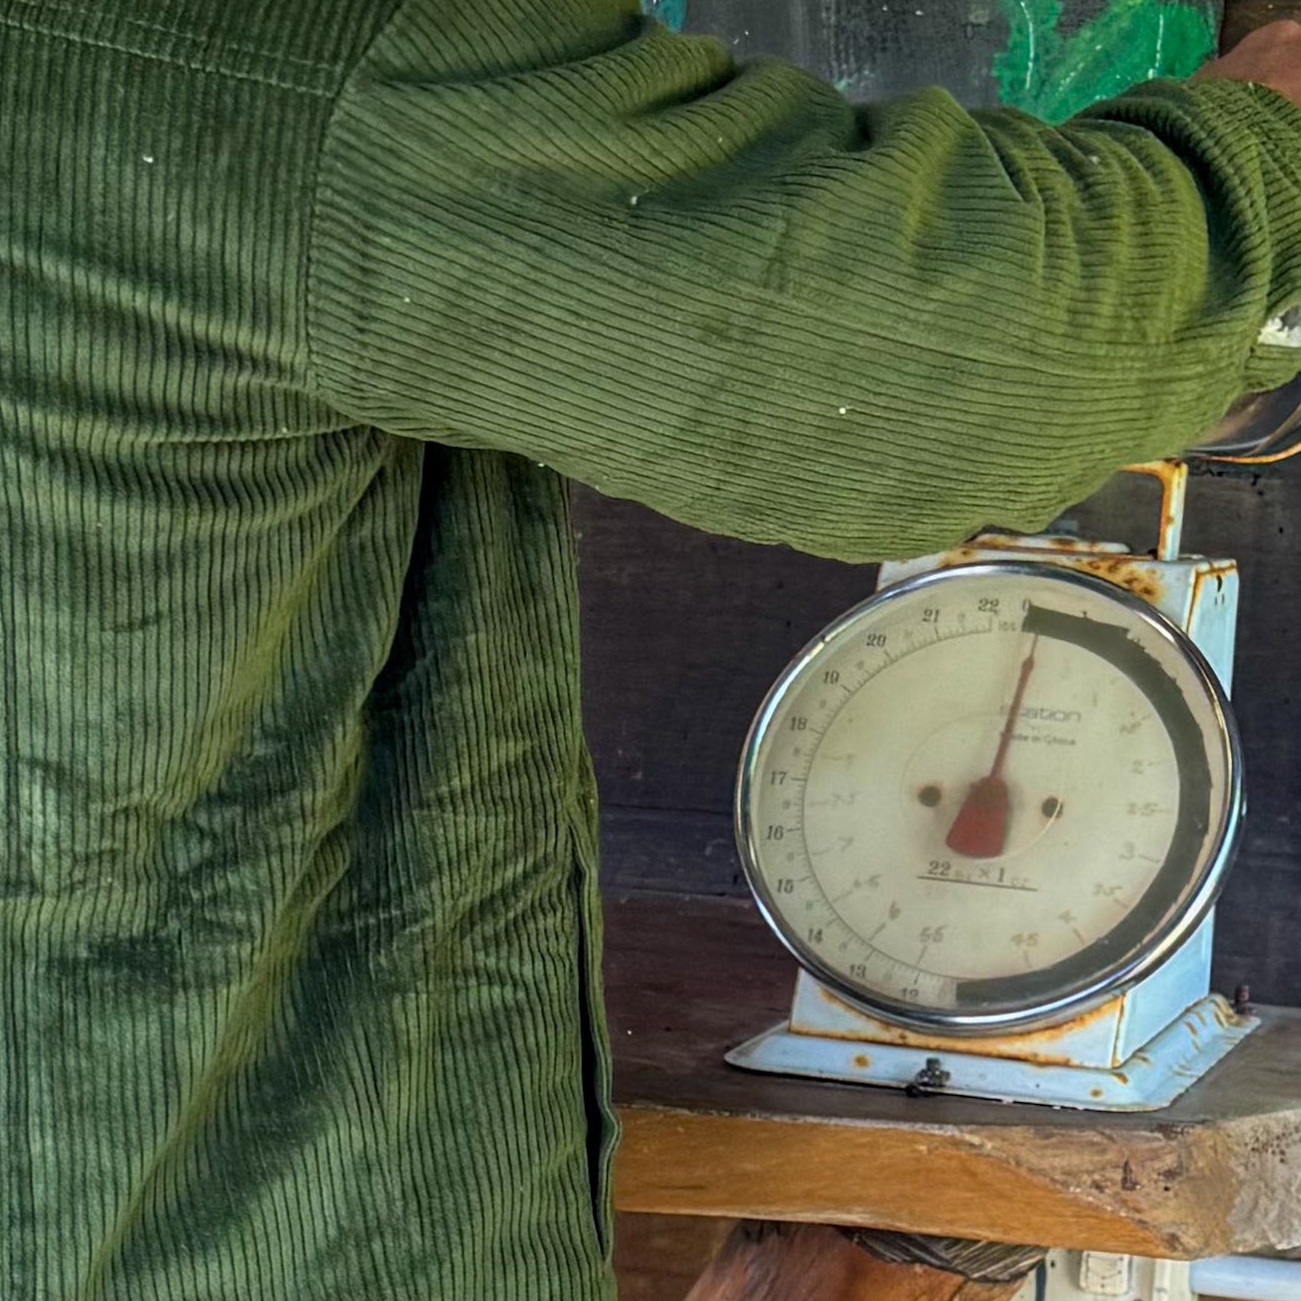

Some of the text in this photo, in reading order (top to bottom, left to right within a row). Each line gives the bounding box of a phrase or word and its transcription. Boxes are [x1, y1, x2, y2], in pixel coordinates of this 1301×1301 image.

[977, 598, 1000, 614] 22
[921, 608, 940, 624] 21
[866, 633, 887, 648] 20
[789, 717, 808, 732] 18
[770, 771, 788, 786] 17
[766, 825, 785, 840] 16
[807, 928, 824, 944] 14
[849, 965, 868, 980] 13
